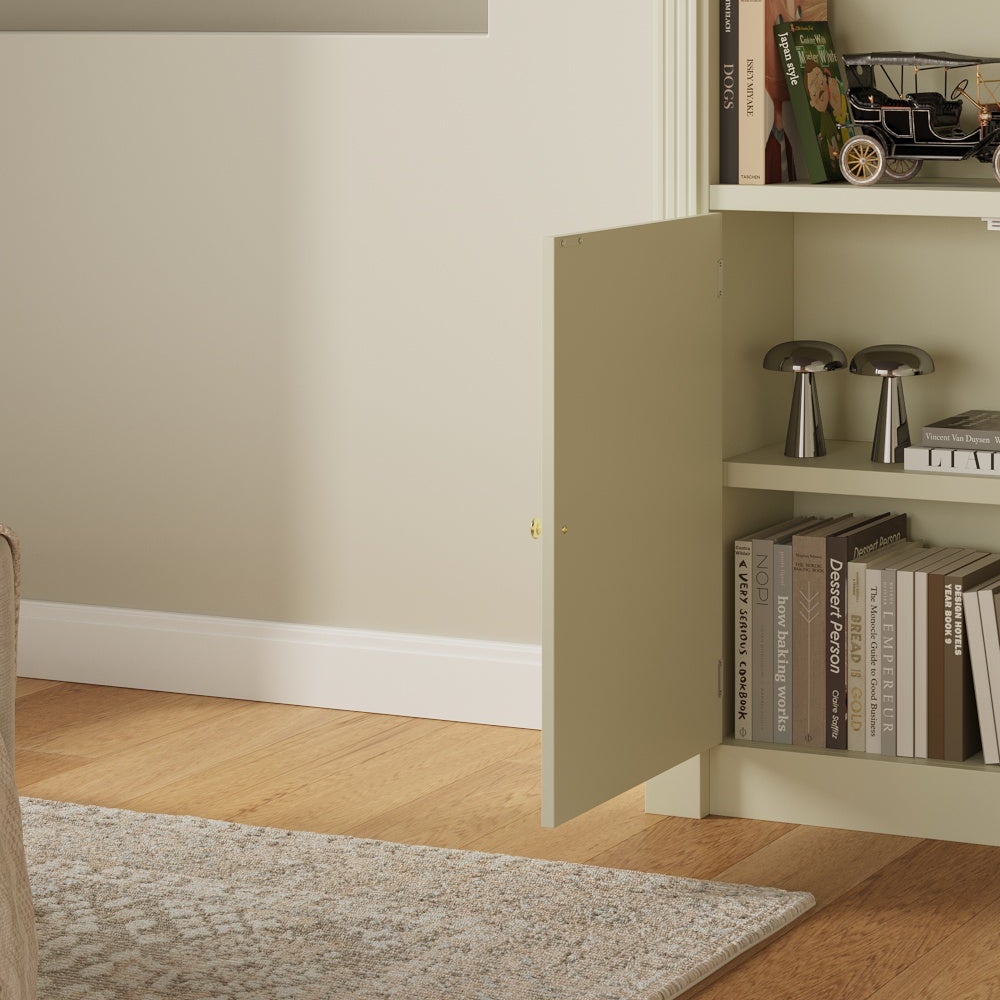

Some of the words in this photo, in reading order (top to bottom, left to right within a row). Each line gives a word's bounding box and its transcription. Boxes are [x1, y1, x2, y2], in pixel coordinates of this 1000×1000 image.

[746, 58, 754, 82] ISSEY
[778, 32, 792, 62] Japan
[786, 63, 798, 86] style
[723, 63, 734, 110] DOGS
[746, 84, 754, 117] MIYAKE
[925, 433, 950, 441] Vincent
[951, 434, 965, 442] Van
[965, 435, 990, 445] Duysen
[739, 560, 747, 568] A
[755, 555, 768, 606] NOPI
[739, 573, 748, 604] VERY
[830, 558, 842, 619] Dessert
[870, 586, 878, 603] The
[739, 609, 748, 655] SERIOUS
[777, 596, 788, 627] how
[870, 605, 878, 640] Monocle
[775, 630, 789, 682] baking
[830, 620, 842, 673] Person
[850, 615, 862, 663] BREAD
[738, 661, 748, 720] COOKBOOK
[883, 610, 894, 732] LEMPEREUR
[777, 687, 788, 732] works
[832, 690, 840, 713] Claire
[851, 687, 863, 732] GOLD
[831, 715, 841, 739] Saffitz
